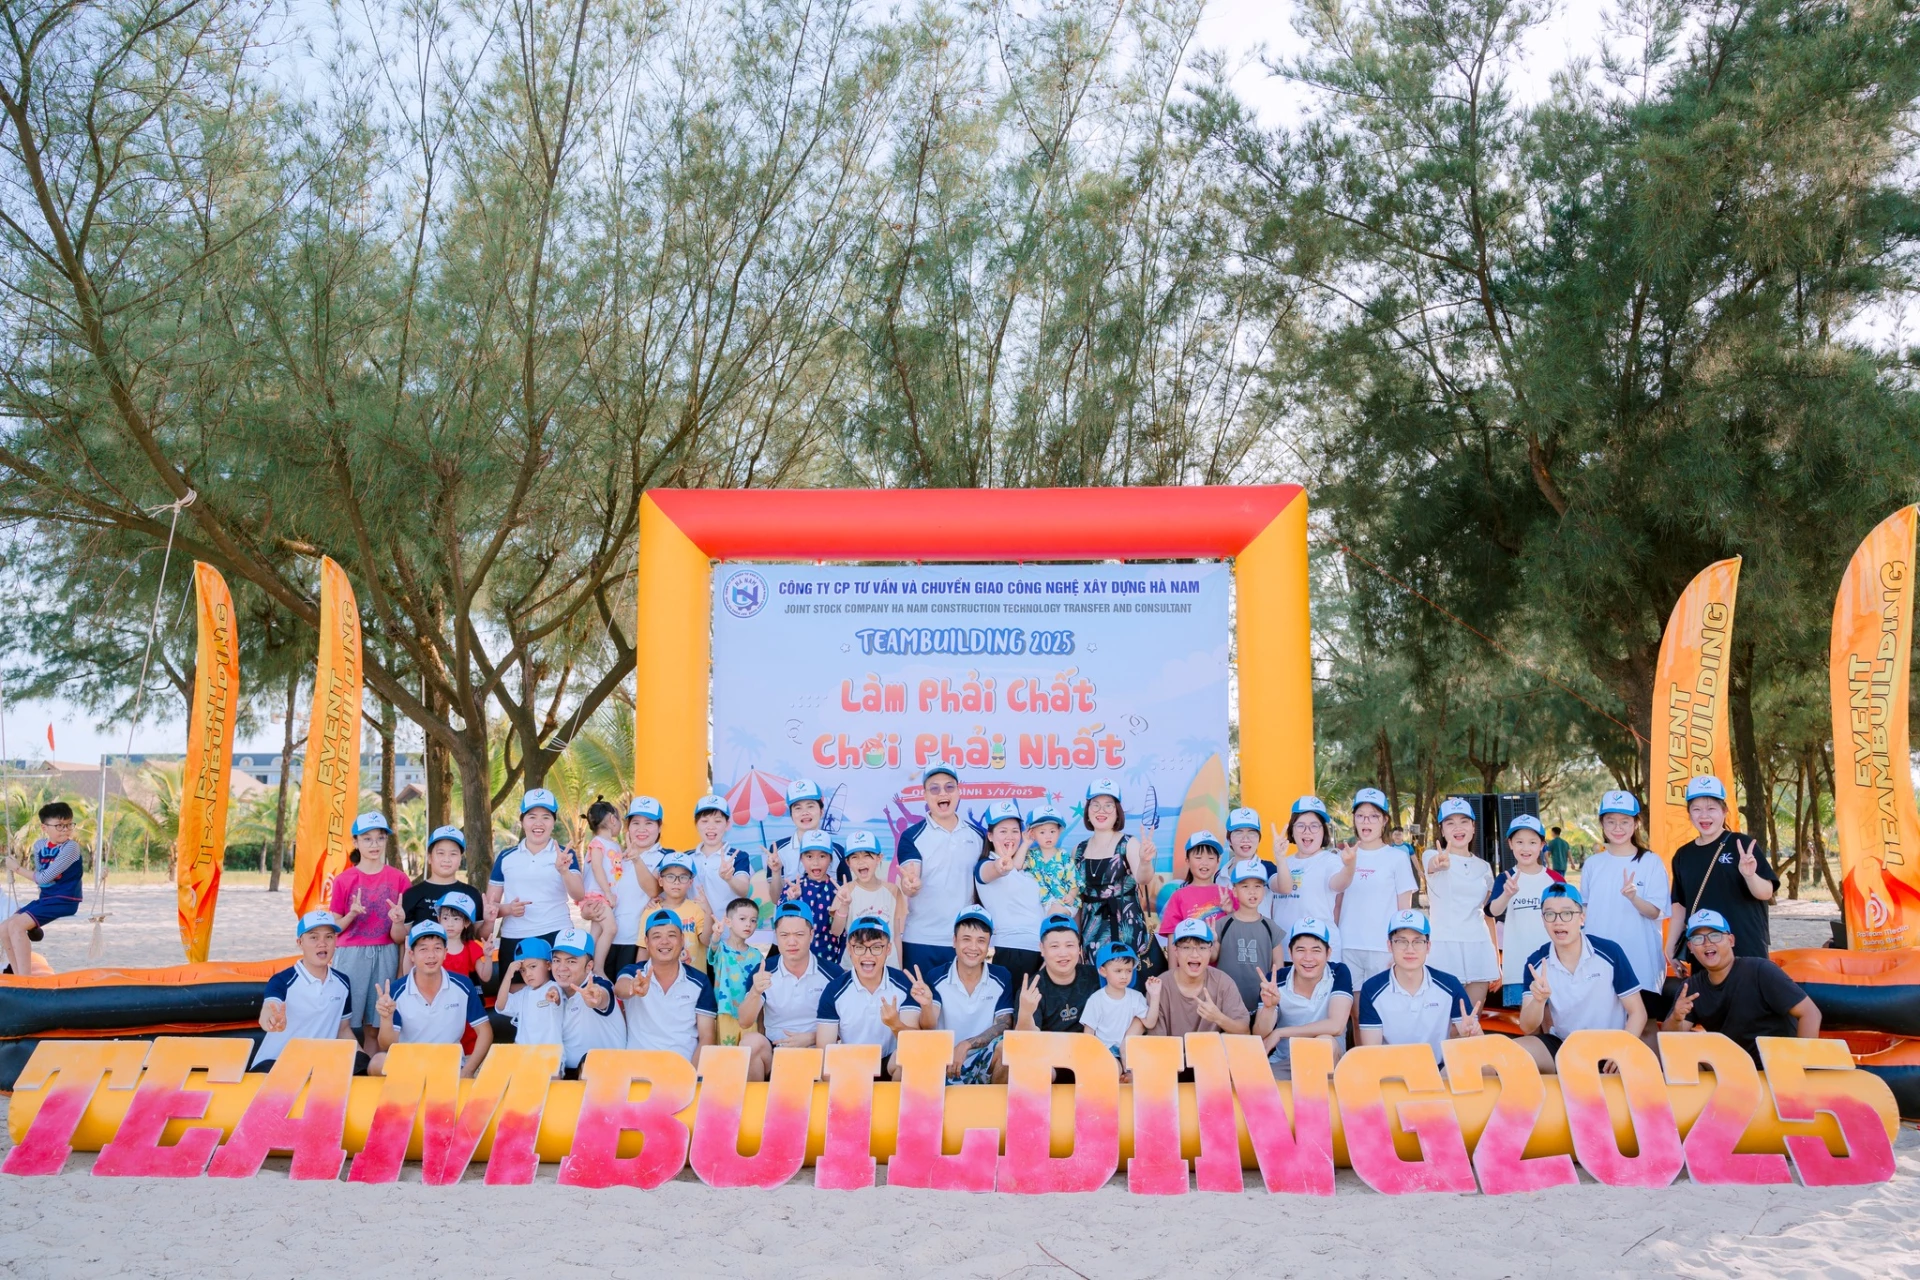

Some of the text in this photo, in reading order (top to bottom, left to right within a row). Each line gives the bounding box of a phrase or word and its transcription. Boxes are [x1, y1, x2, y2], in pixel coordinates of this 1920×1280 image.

[779, 580, 812, 595] CÔNG
[817, 582, 830, 595] TY
[834, 582, 850, 594] CP
[854, 581, 871, 594] TƯ
[873, 577, 898, 594] VẤN
[902, 579, 918, 594] VÀ
[974, 582, 1004, 594] GIAO
[1008, 579, 1042, 594] CÔNG
[1046, 579, 1079, 596] NGHỆ
[1083, 578, 1108, 594] XÂY
[1111, 580, 1146, 596] DỰNG
[1149, 578, 1167, 594] HÀ
[1171, 581, 1200, 594] NAM
[784, 603, 1192, 614] JOINT STOCK COMPANY HA NAM CONSTRUCTION TECHNOLOGY TRANSFER AND CONSULTANT
[856, 627, 1075, 655] TEAMBUILDING 2025
[317, 668, 343, 786] EVENT
[327, 600, 355, 856] TEAMBUILDING
[841, 666, 1097, 714] Làm Phải Chất
[1690, 602, 1729, 777] BUILDING
[1849, 653, 1872, 788] EVENT
[1871, 560, 1907, 871] TEAMBUILDING
[812, 722, 1126, 769] Chơi Phải Nhất
[1666, 682, 1691, 806] EVENT
[987, 787, 1033, 797] 3/8/2025
